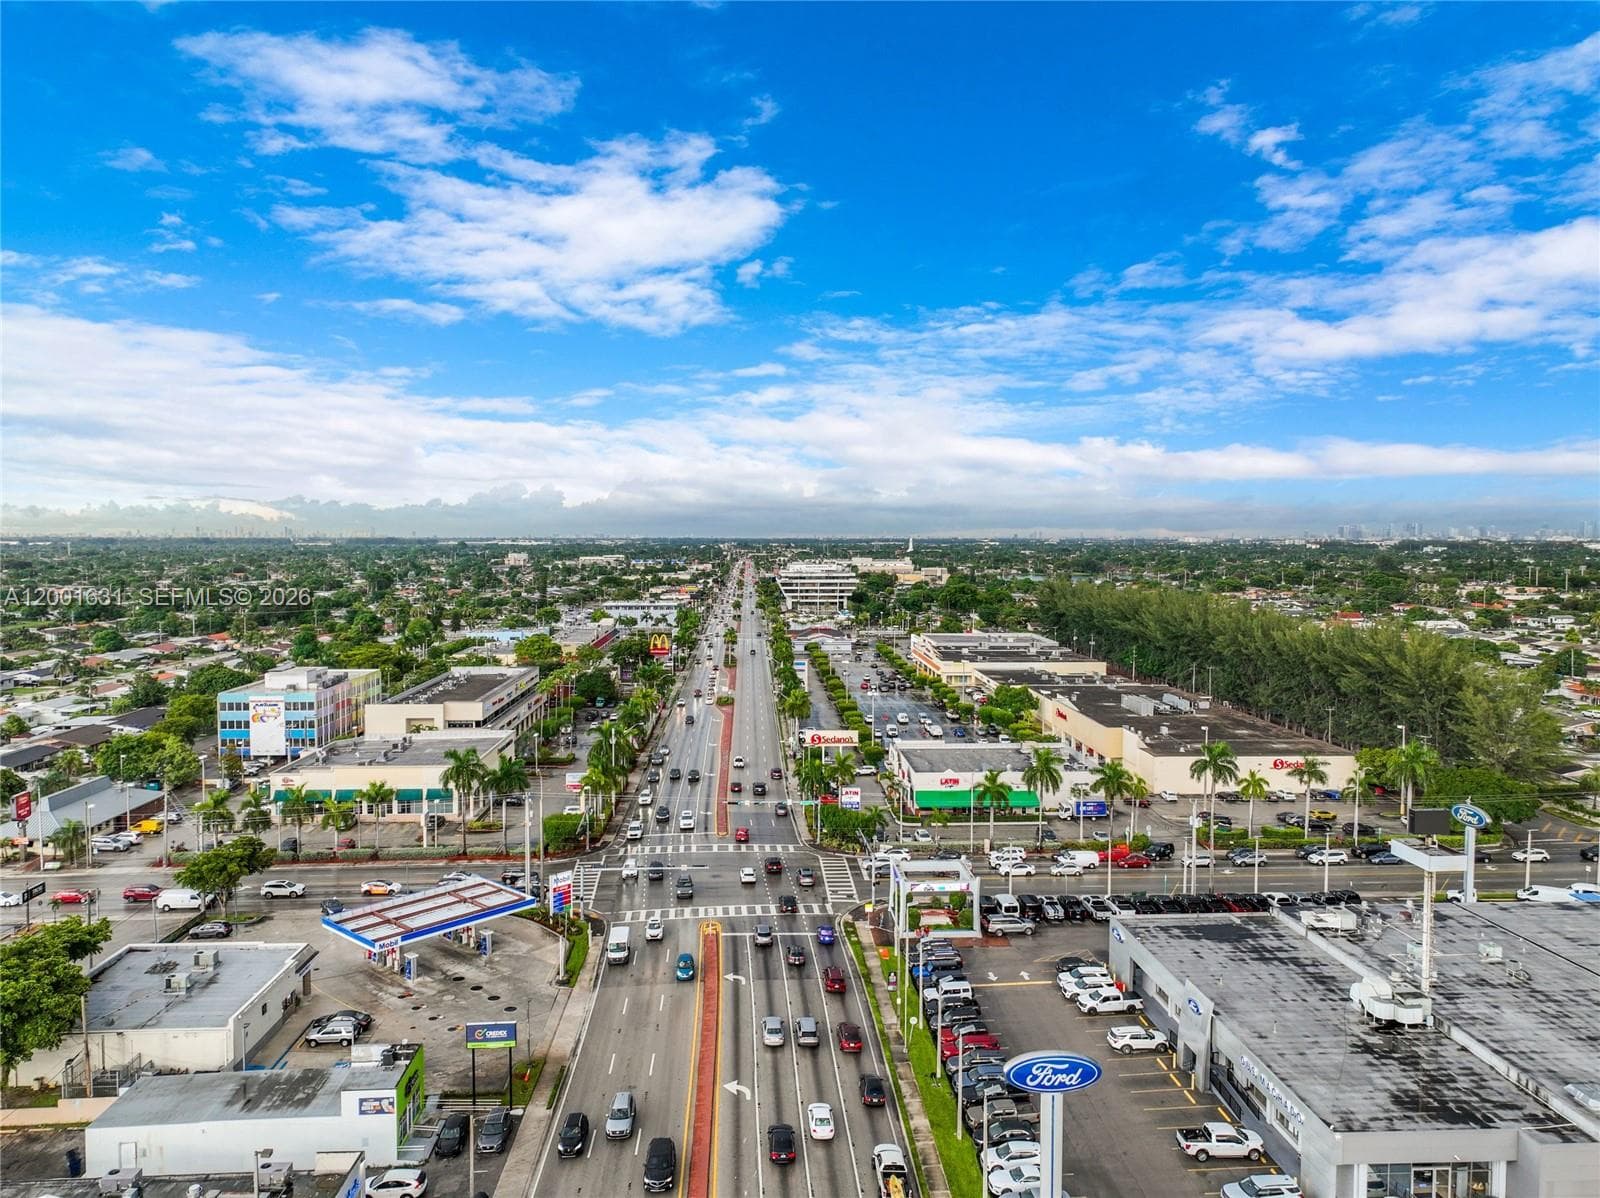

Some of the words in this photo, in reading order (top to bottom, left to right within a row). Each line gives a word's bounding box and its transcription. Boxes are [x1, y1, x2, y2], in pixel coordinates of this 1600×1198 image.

[822, 735, 854, 745] Sedano's
[940, 777, 960, 786] LATIN
[1456, 807, 1480, 825] Ford
[378, 938, 399, 950] Mobil
[1025, 1062, 1083, 1087] Ford
